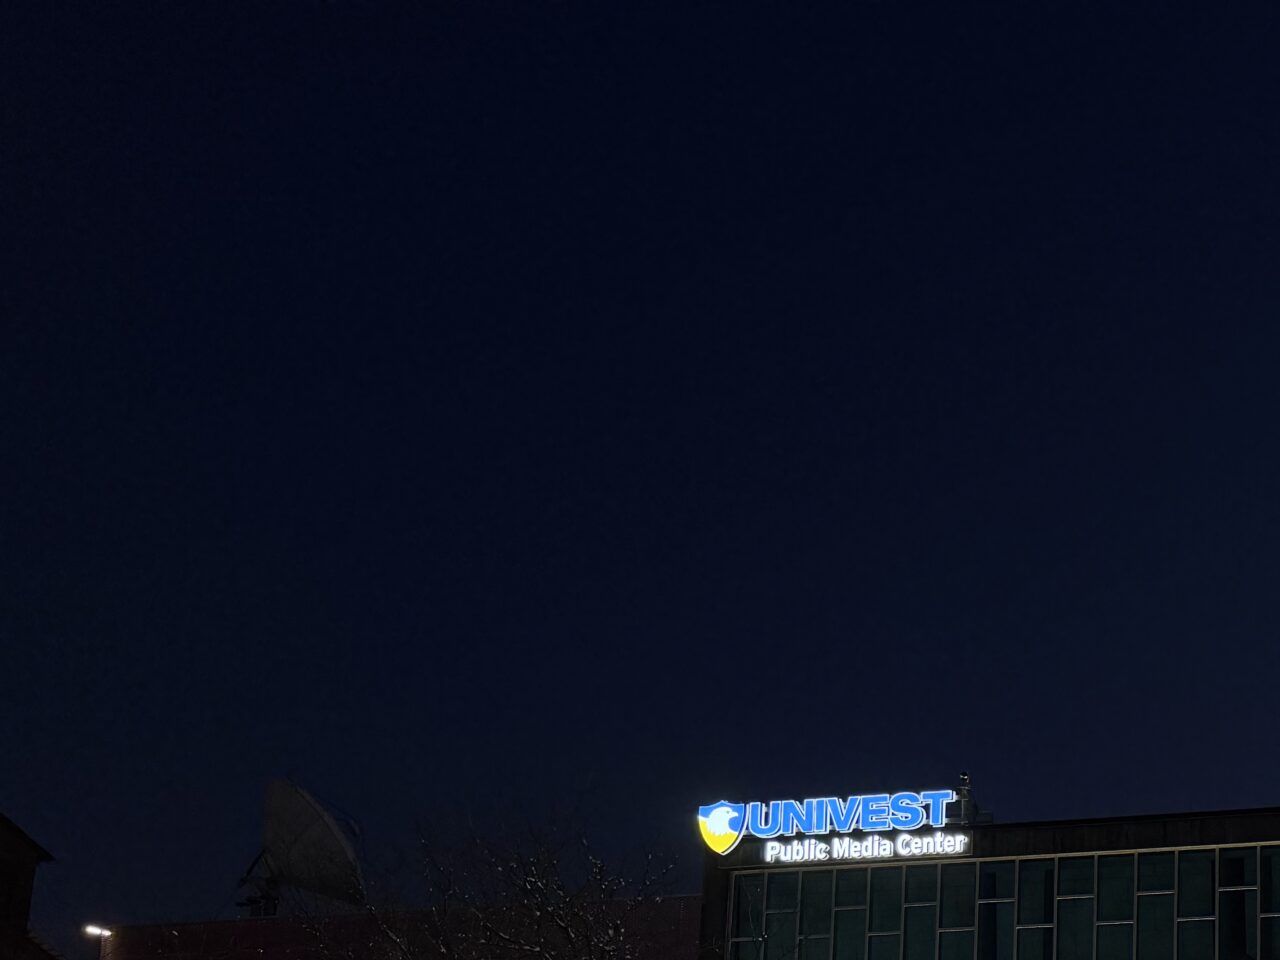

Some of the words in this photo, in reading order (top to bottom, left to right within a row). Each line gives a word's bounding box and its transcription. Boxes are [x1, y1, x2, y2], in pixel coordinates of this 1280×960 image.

[748, 789, 955, 838] UNIVEST
[764, 838, 829, 863] Public
[832, 835, 894, 860] Media
[897, 831, 969, 856] Center
